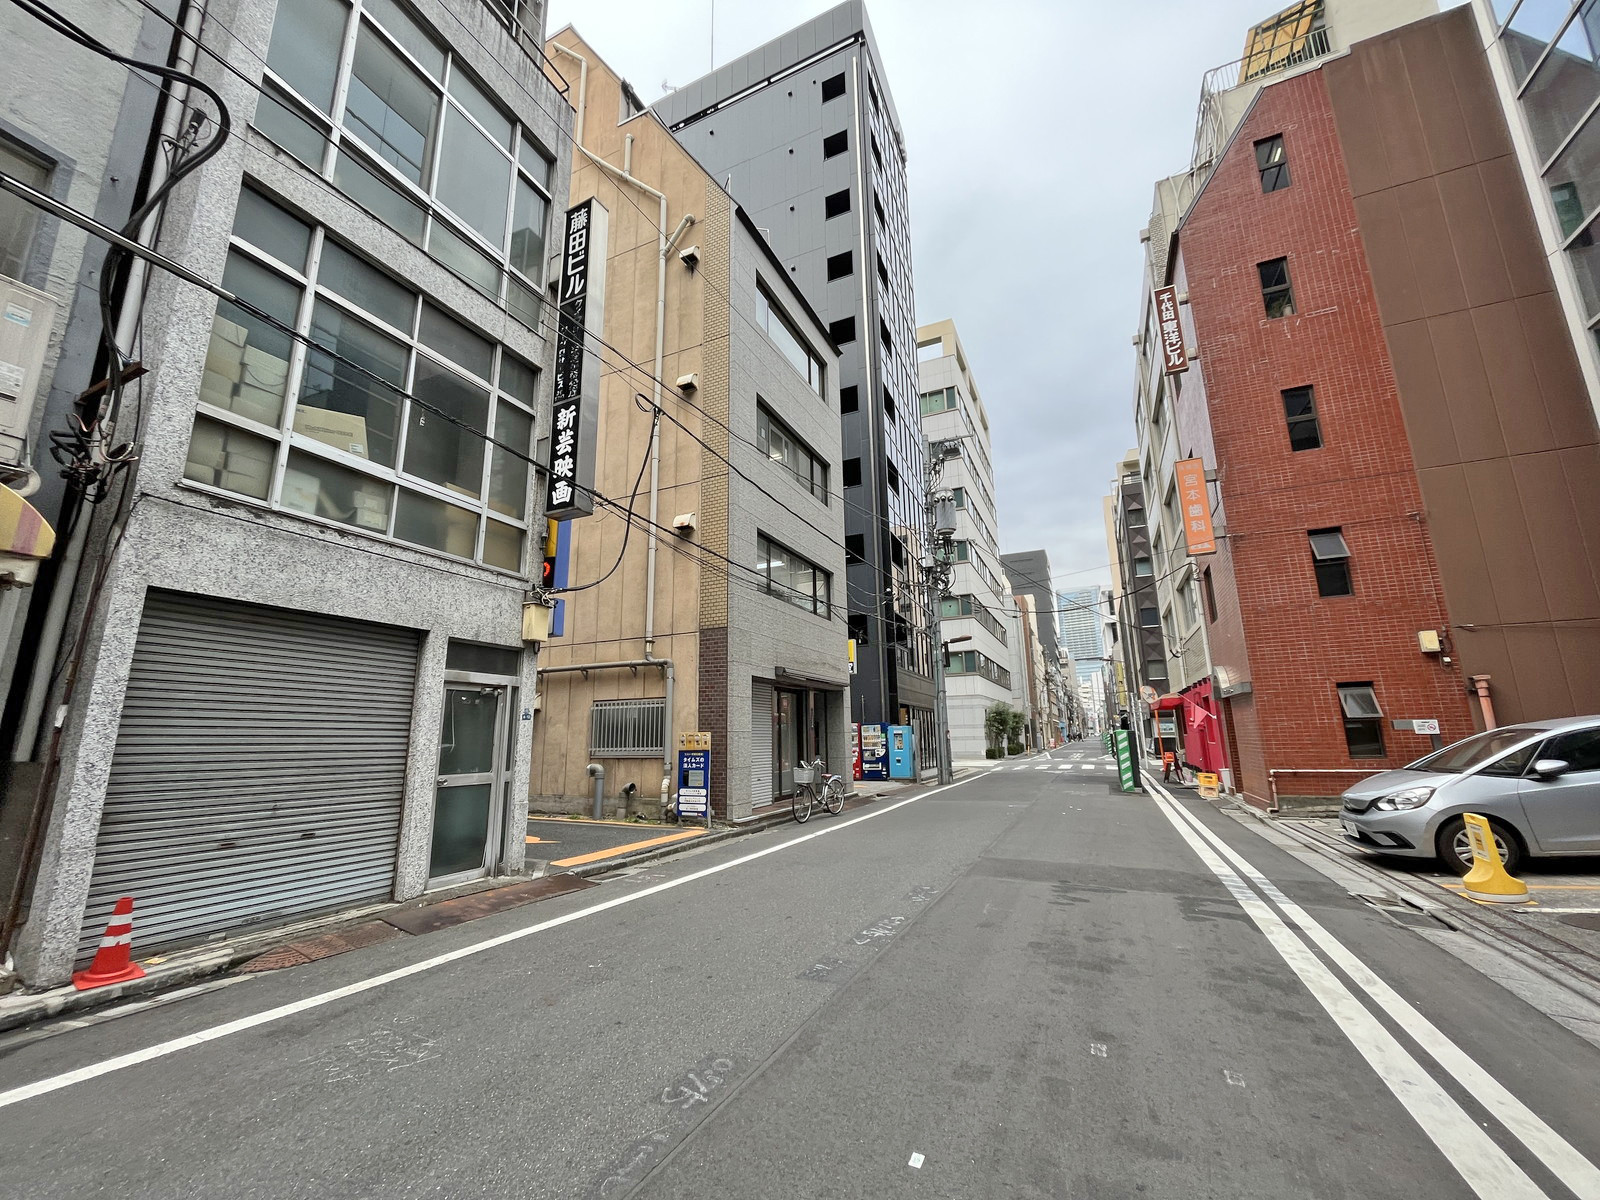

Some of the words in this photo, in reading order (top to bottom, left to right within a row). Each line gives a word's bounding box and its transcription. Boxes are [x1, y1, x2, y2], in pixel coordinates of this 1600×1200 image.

[565, 207, 588, 299] 藤田ビル
[1159, 292, 1184, 367] 千代田東洋ビル
[552, 404, 577, 506] 新芸映画
[1183, 474, 1206, 533] 宮本歯科
